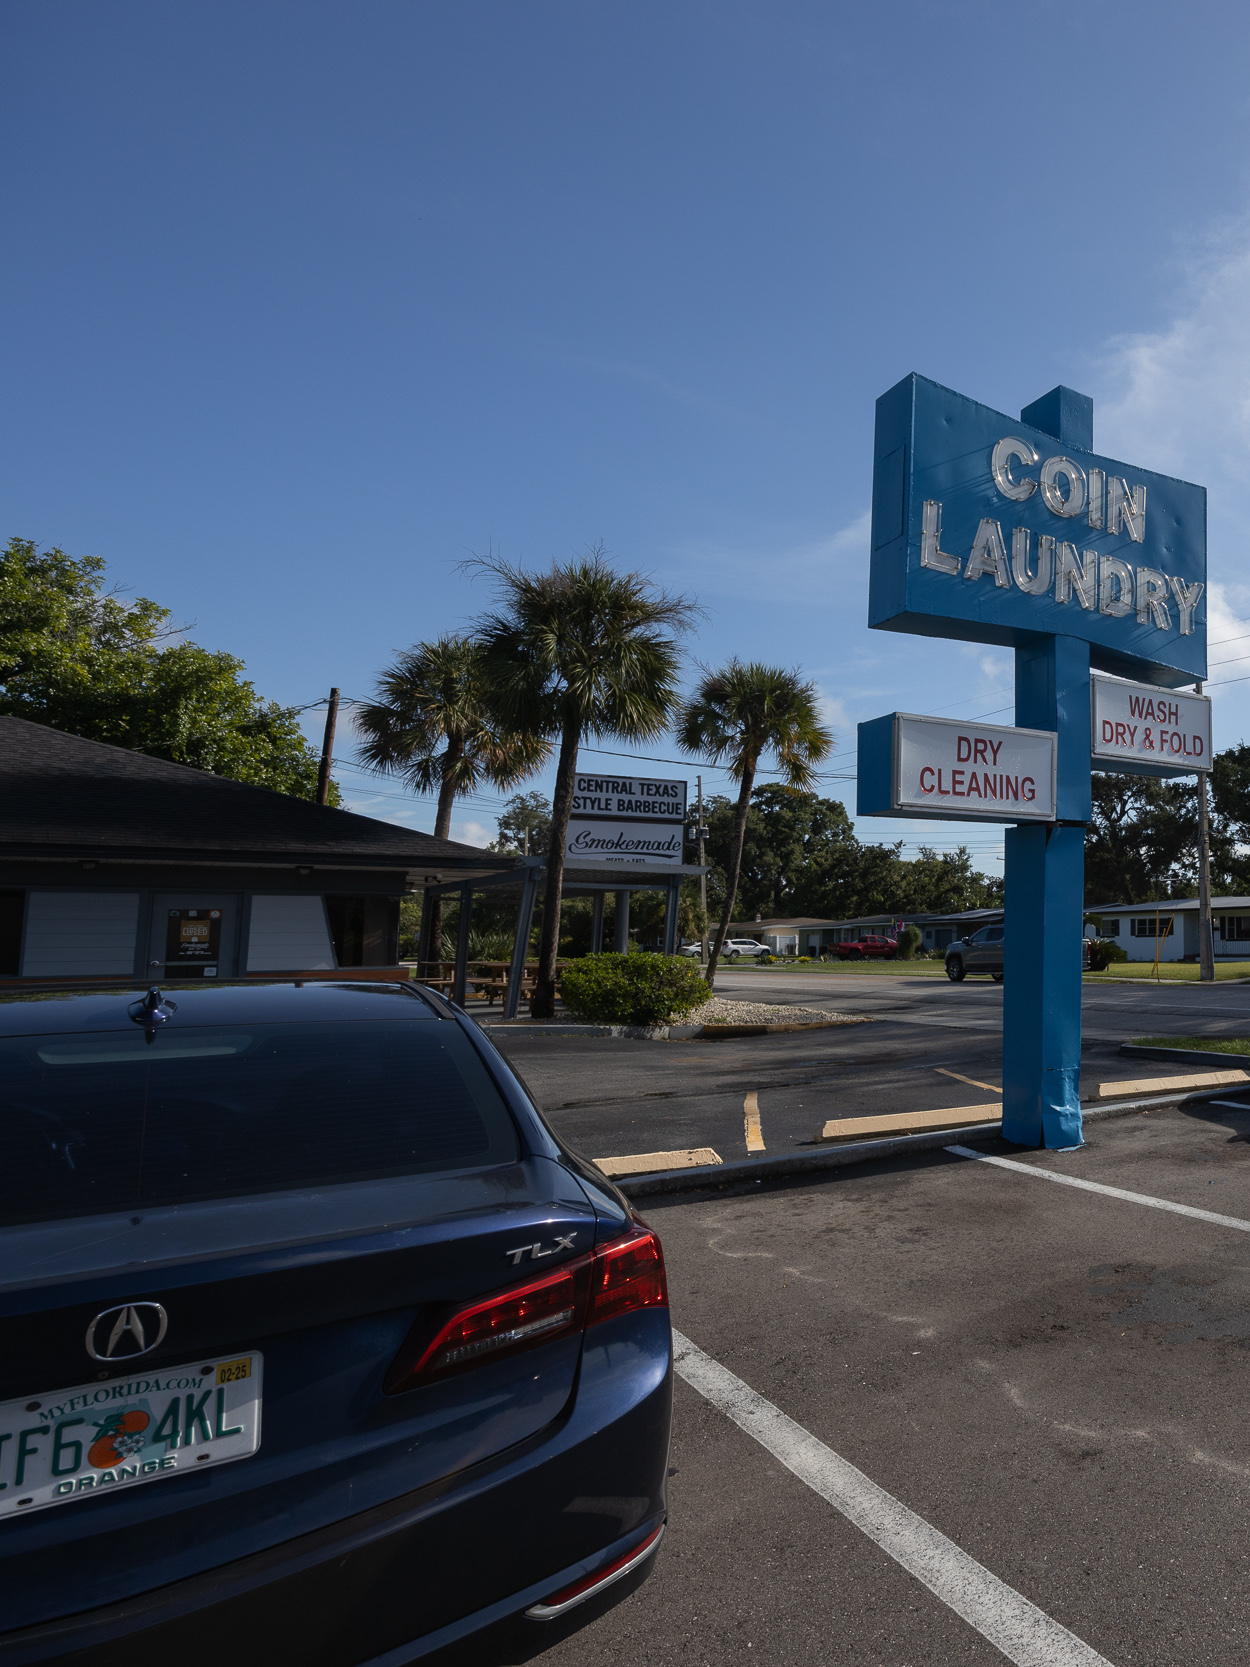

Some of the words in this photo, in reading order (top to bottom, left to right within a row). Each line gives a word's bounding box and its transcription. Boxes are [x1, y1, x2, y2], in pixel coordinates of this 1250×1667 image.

[991, 436, 1147, 543] COIN
[920, 500, 1204, 635] LAUNDRY
[1129, 695, 1179, 726] WASH
[956, 736, 1003, 766] DRY
[1102, 720, 1138, 749] DRY
[1143, 728, 1155, 751] &
[1160, 729, 1204, 757] FOLD
[577, 778, 636, 795] CENTRAL
[639, 782, 678, 798] TEXAS
[919, 766, 1036, 801] CLEANING
[572, 796, 612, 811] STYLE
[617, 799, 682, 815] BARBECUE
[568, 830, 681, 855] Smokemade
[182, 927, 208, 936] CLOSED
[506, 1232, 577, 1265] TLX
[220, 1364, 247, 1383] 02-25
[39, 1377, 204, 1423] MYFLORIDA.COM
[57, 1455, 178, 1495] ORANGE
